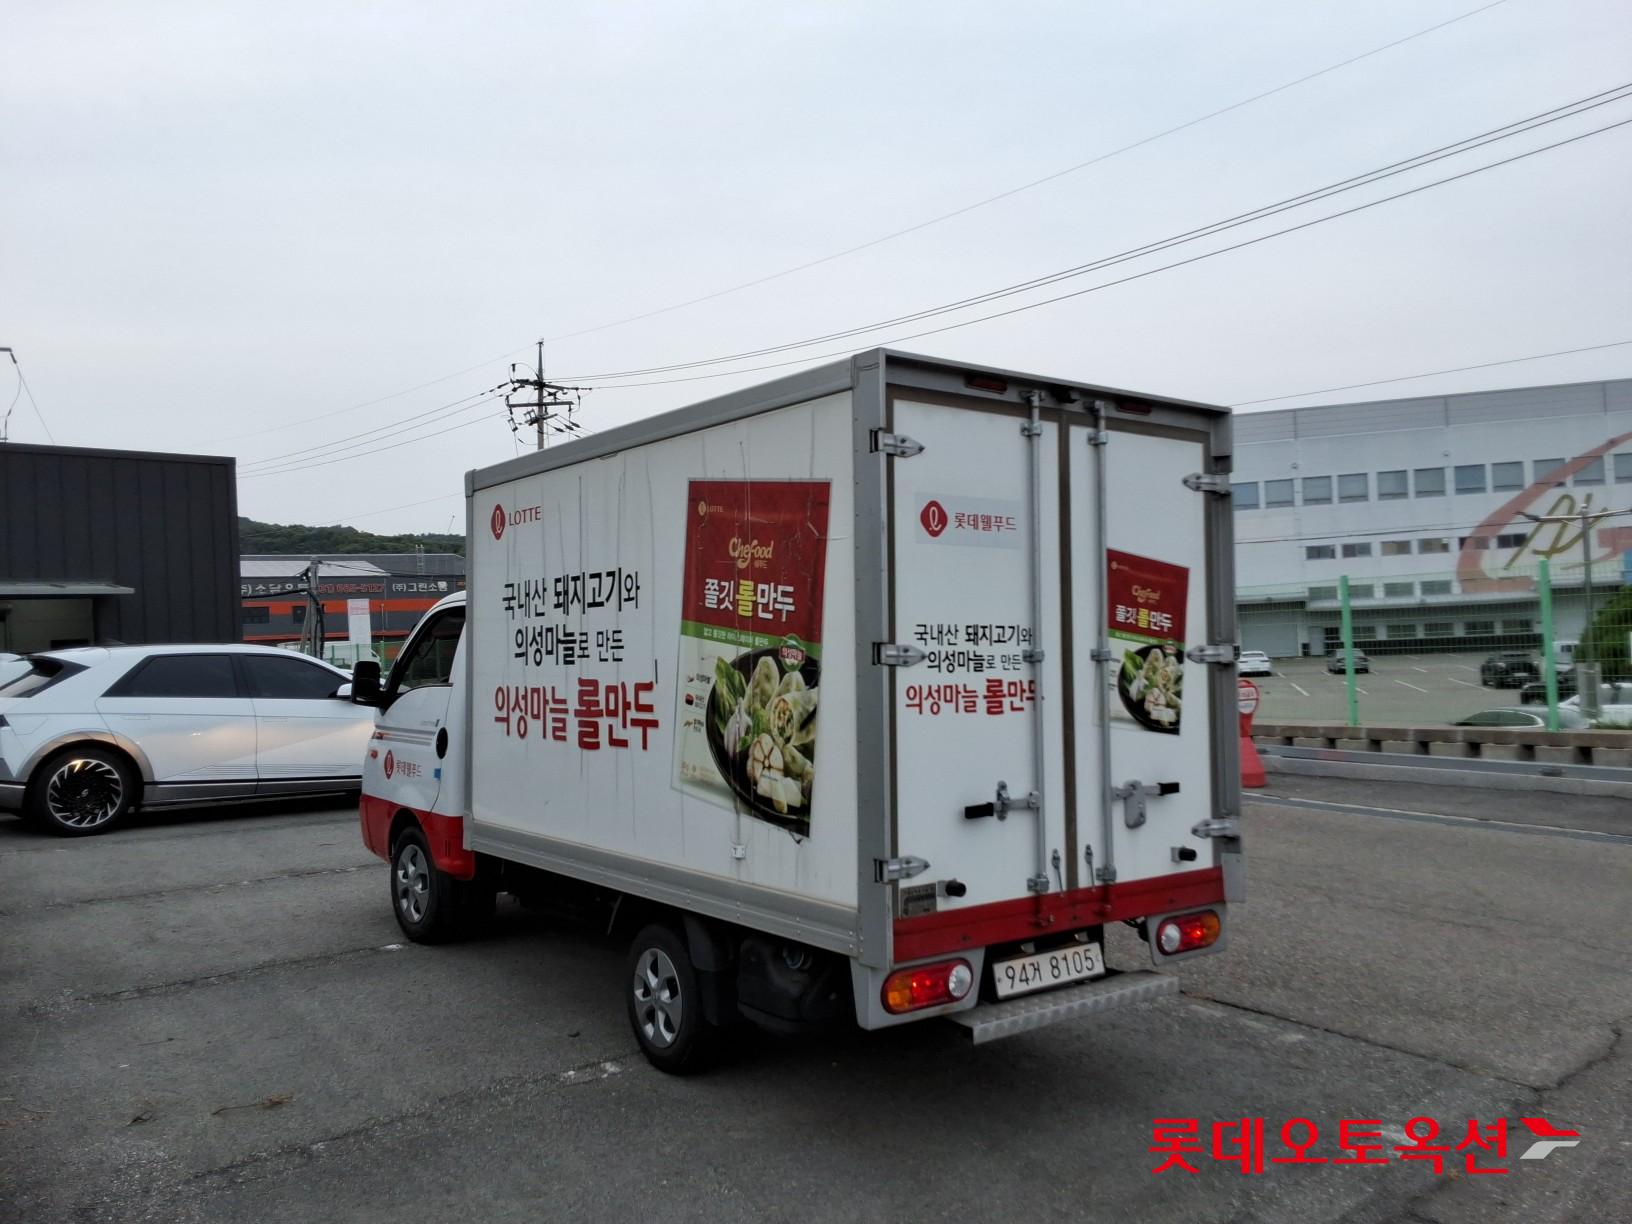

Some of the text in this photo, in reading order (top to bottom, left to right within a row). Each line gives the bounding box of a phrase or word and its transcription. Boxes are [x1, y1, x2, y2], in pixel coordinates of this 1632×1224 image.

[508, 505, 542, 526] LOTTE
[954, 511, 1017, 532] 롯데웰푸드
[729, 537, 774, 569] Chefood
[502, 567, 640, 620] 국내산 돼지고기와
[515, 624, 624, 667] 의성마늘로 만든
[914, 624, 1033, 646] 국내산 돼지고기와
[927, 650, 1022, 673] 의성마늘로 만든
[494, 677, 659, 751] 의성마늘 롤만두
[905, 683, 979, 715] 의성마늘
[1050, 949, 1094, 979] 8105
